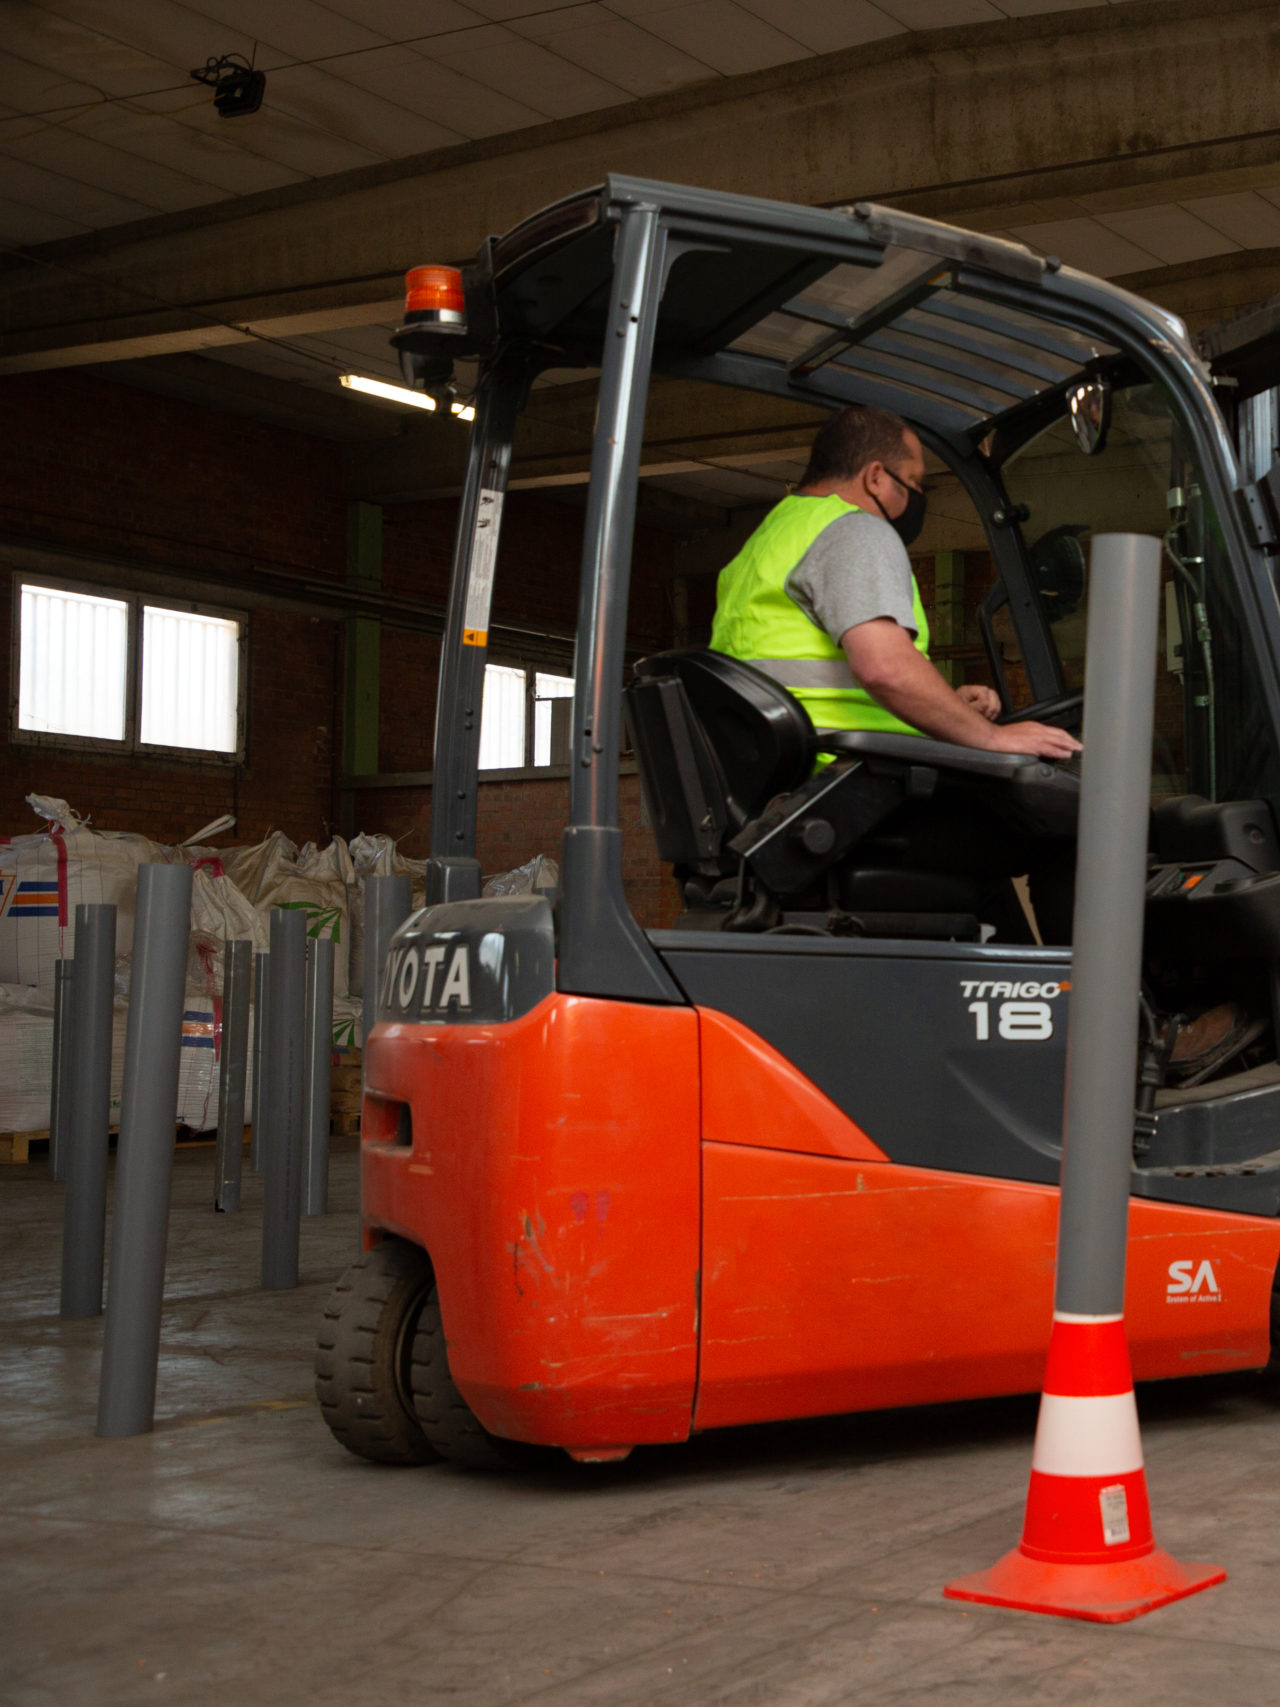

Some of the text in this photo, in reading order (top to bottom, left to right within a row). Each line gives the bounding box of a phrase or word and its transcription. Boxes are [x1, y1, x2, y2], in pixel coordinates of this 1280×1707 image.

[380, 945, 471, 1007] YOTA
[968, 1001, 1053, 1040] 18
[1167, 1260, 1218, 1293] SA
